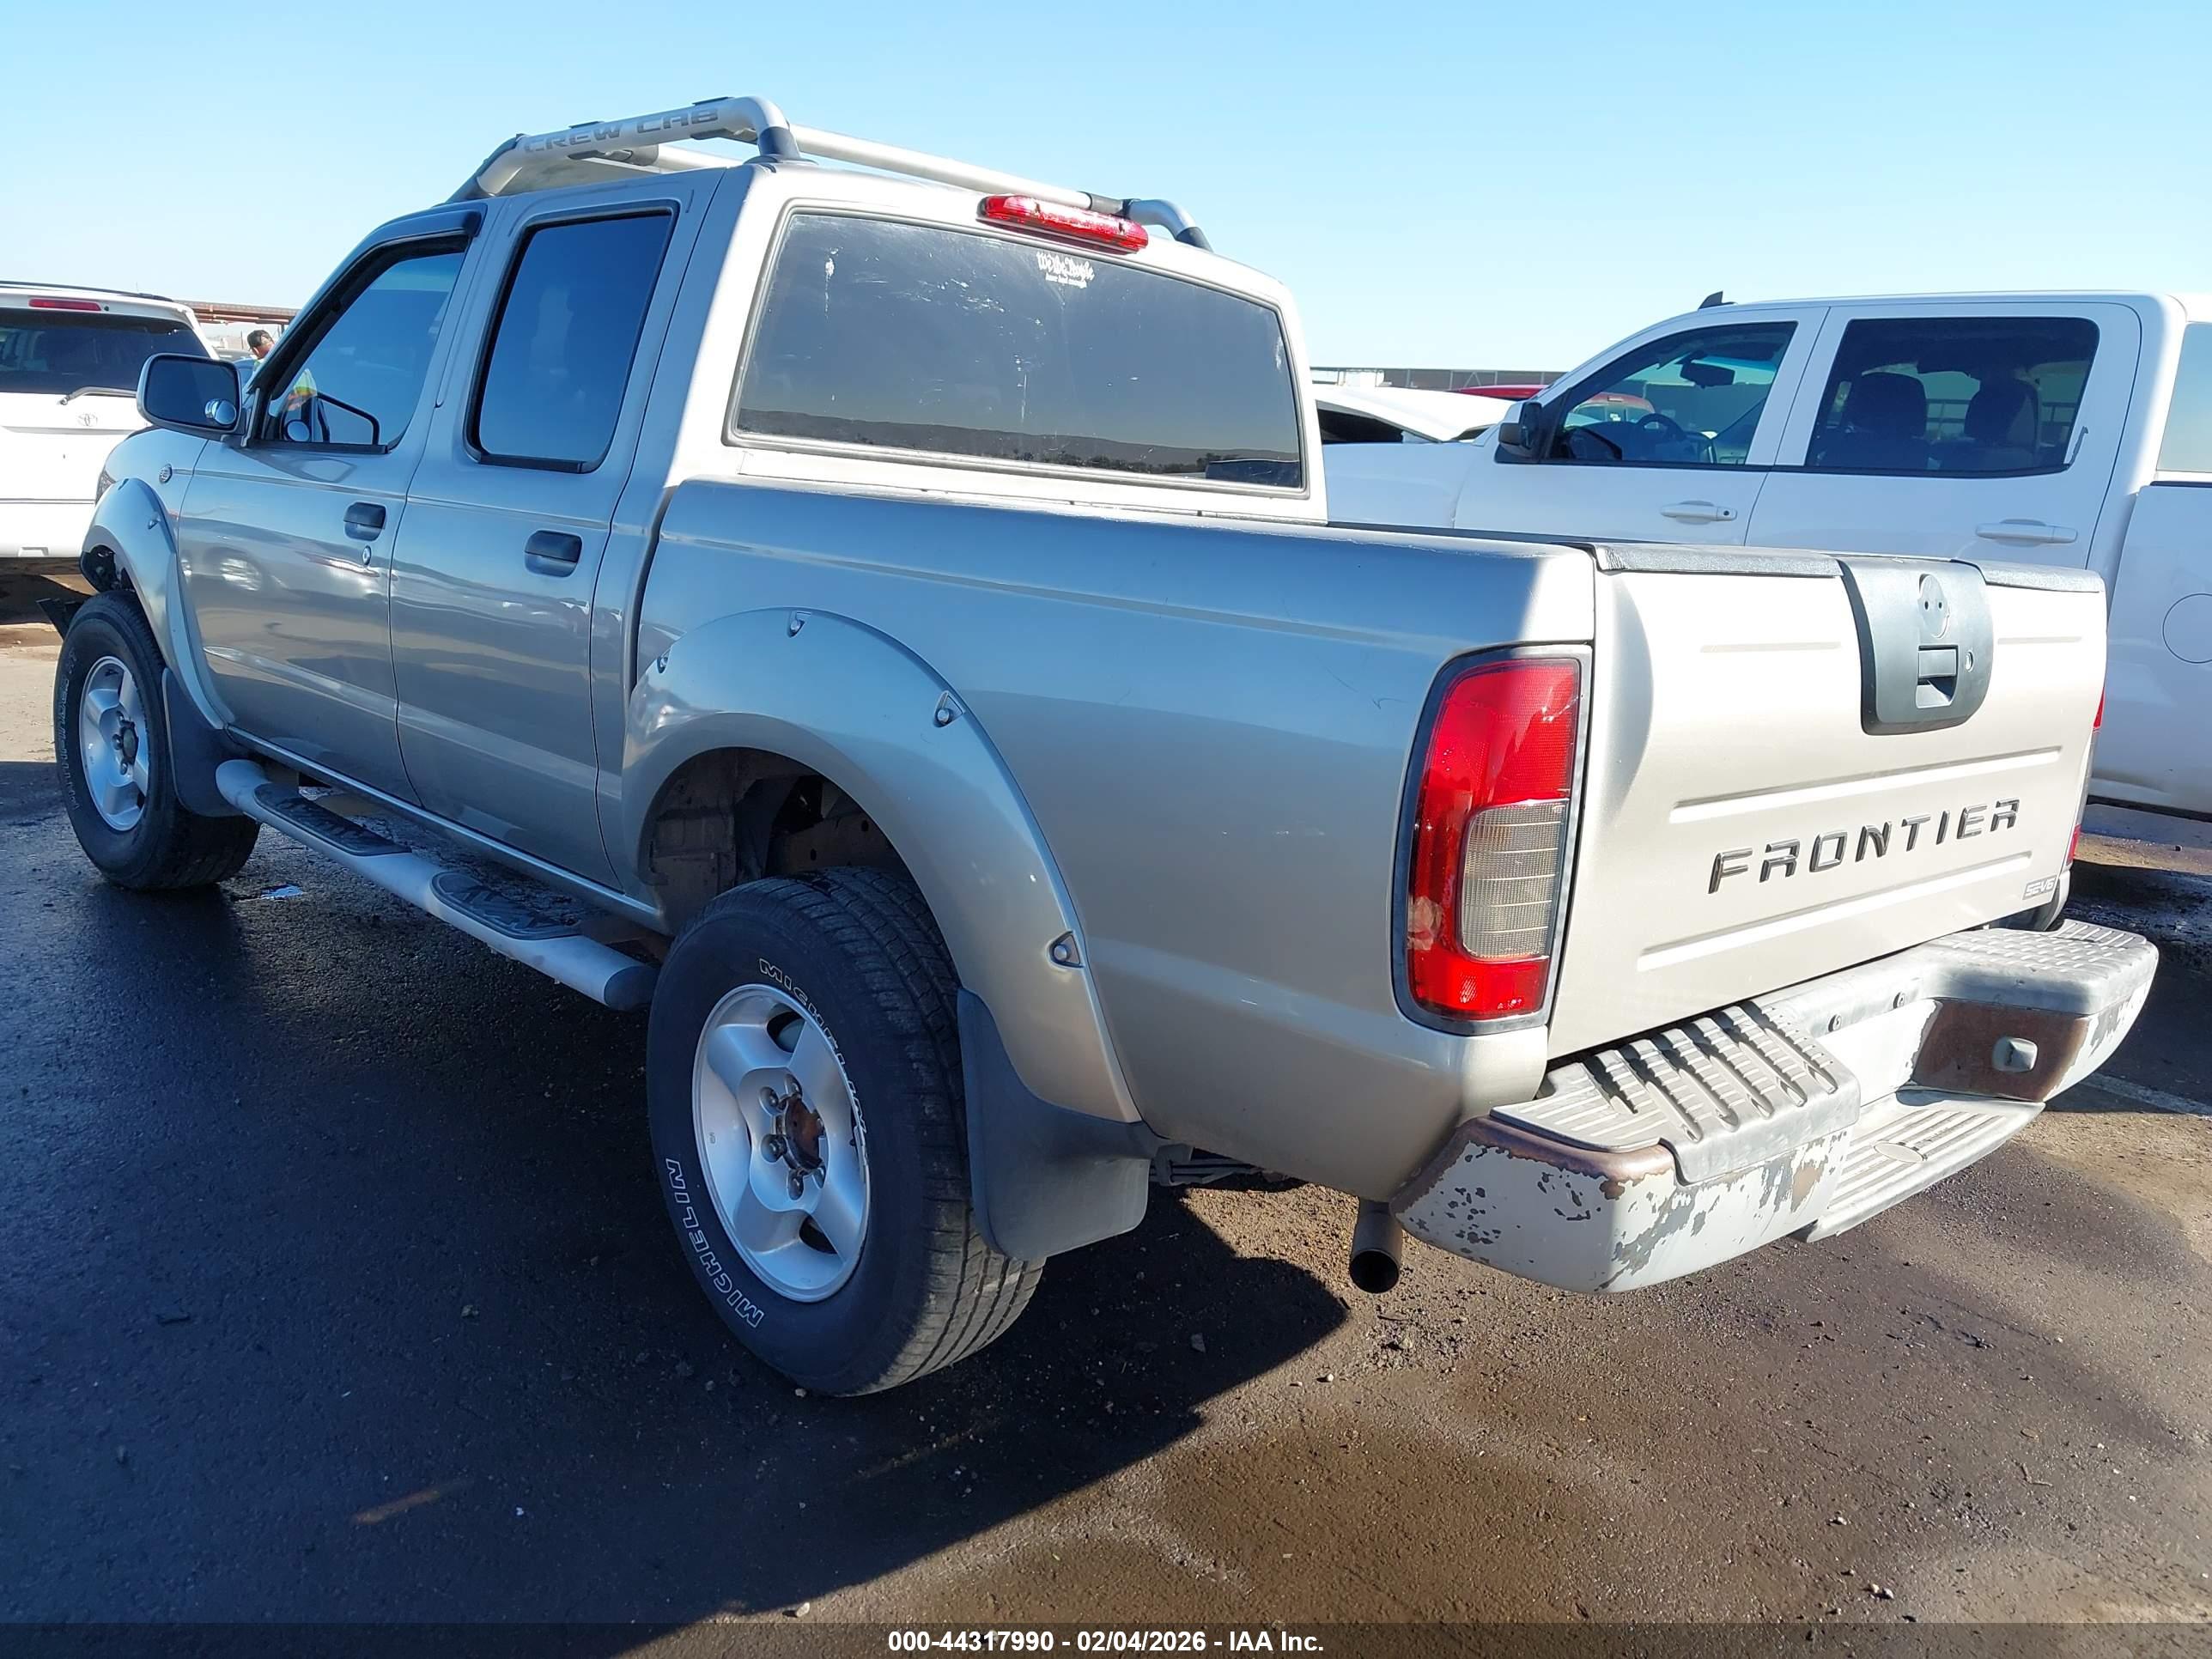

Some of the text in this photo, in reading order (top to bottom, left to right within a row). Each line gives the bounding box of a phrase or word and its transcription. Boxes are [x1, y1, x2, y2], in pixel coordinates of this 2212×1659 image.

[524, 108, 719, 153] CREW CAB
[1707, 797, 2021, 895] FRONTIER
[665, 1158, 765, 1328] MICHELIN
